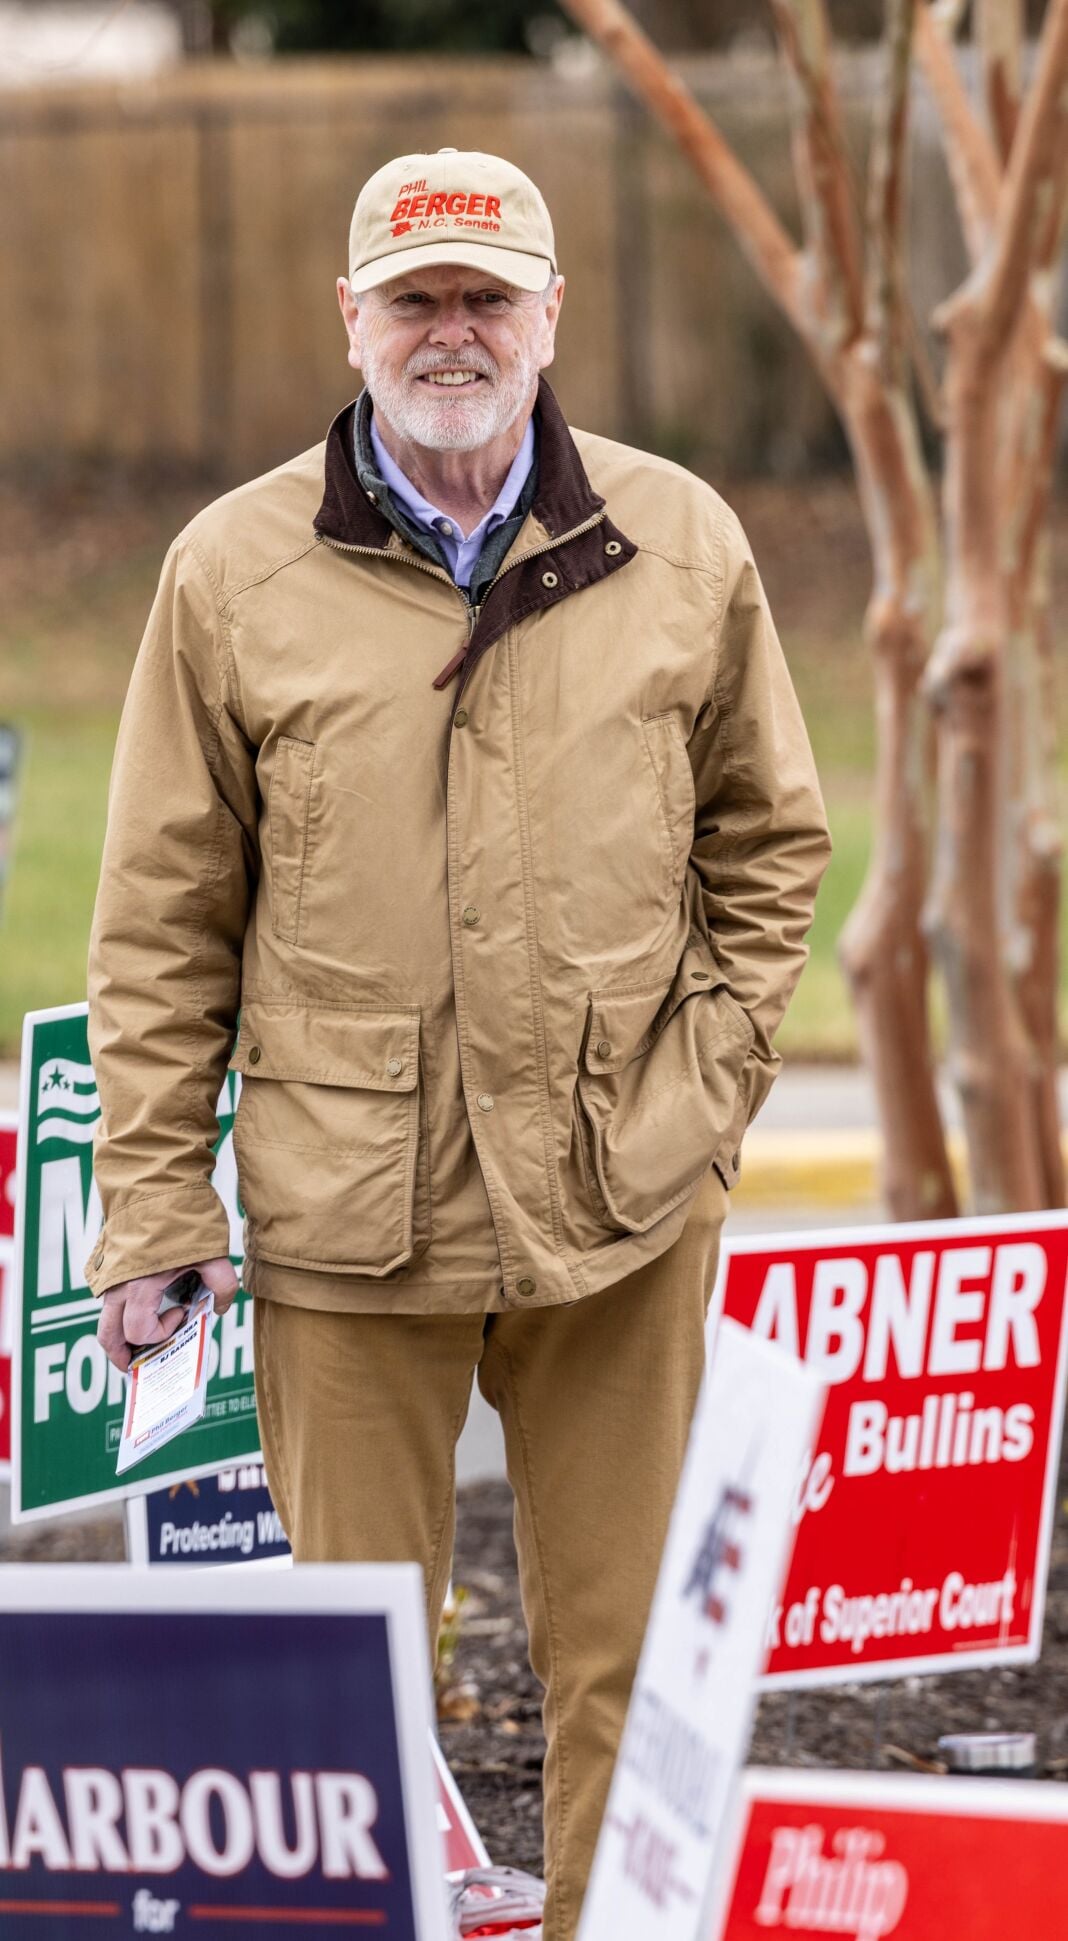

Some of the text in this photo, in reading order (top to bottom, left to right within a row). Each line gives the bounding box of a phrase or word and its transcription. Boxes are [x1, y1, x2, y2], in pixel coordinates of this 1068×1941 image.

[390, 191, 501, 222] BERGER
[398, 179, 428, 197] PHIL
[418, 217, 501, 232] N.C. Senate
[750, 1241, 1048, 1386] ABNER
[842, 1391, 1036, 1477] Bullins
[159, 1511, 255, 1556] Protecting
[785, 1586, 821, 1648] of
[820, 1576, 940, 1655] Superior
[939, 1571, 1016, 1631] Court
[0, 1765, 389, 1881] ARBOUR
[132, 1887, 180, 1932] for
[753, 1823, 909, 1941] Philip
